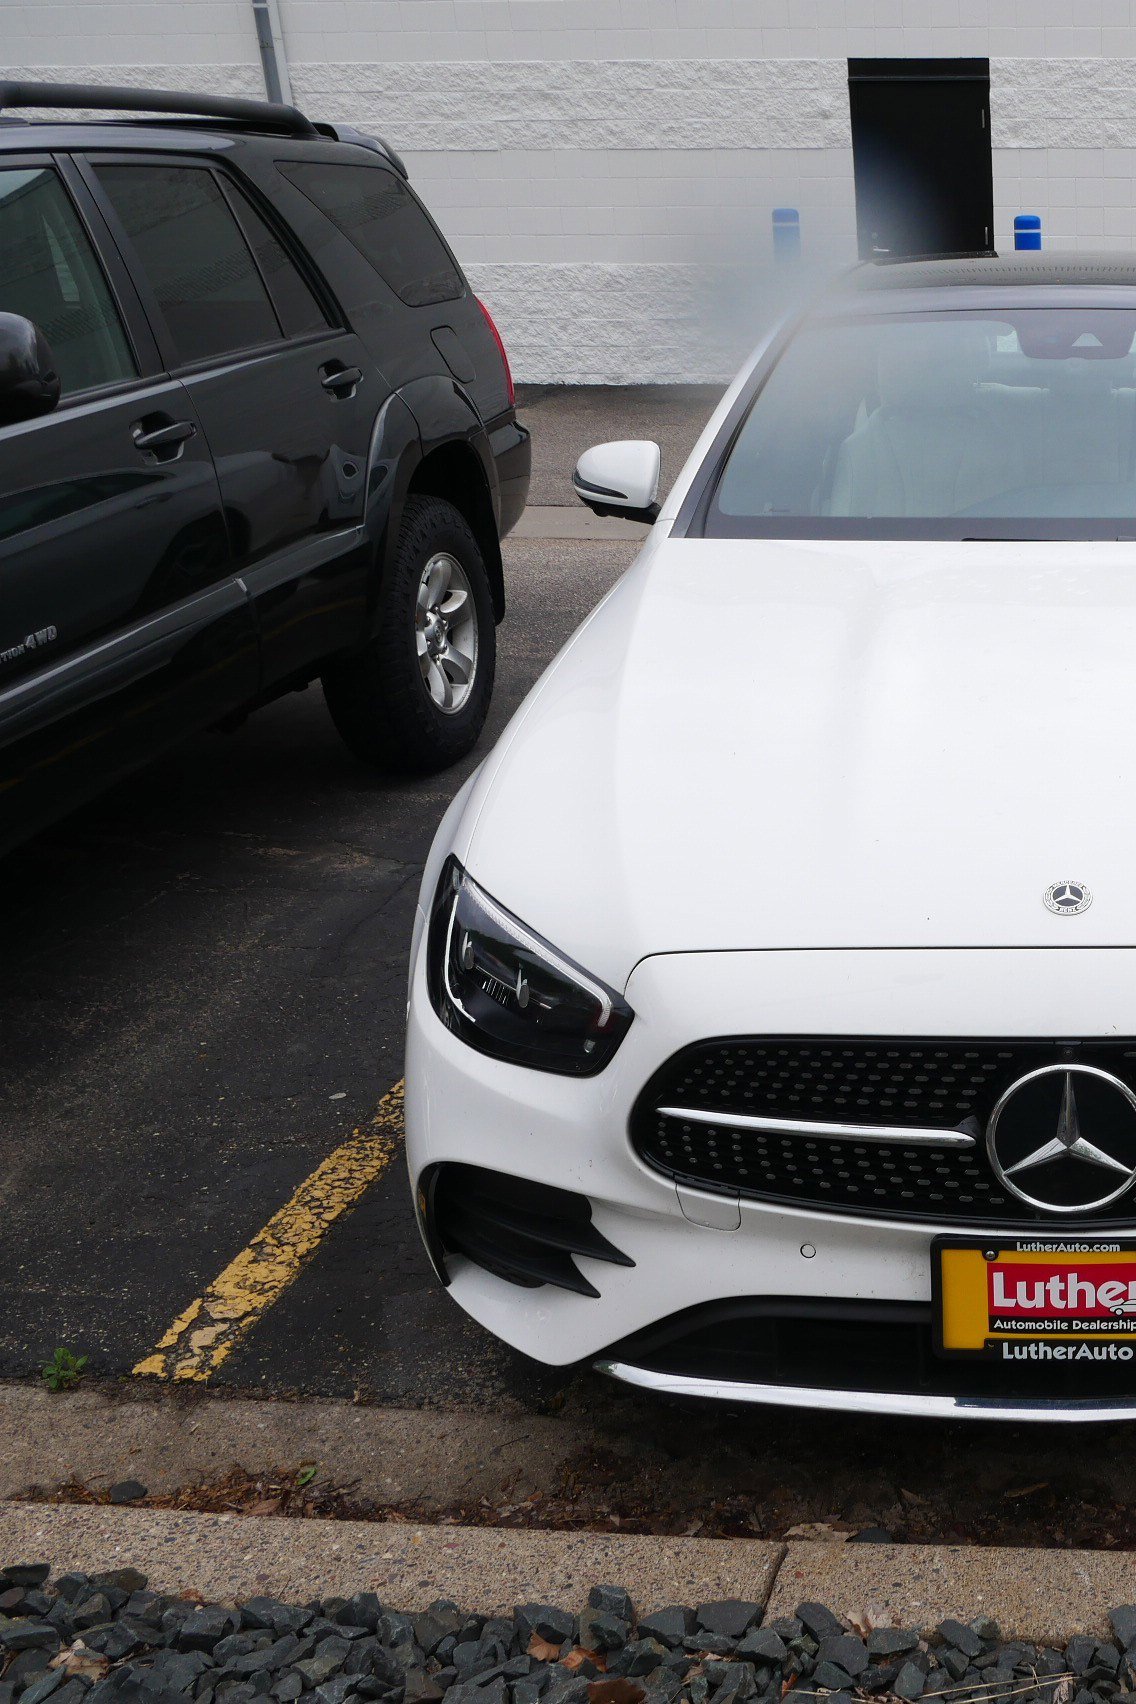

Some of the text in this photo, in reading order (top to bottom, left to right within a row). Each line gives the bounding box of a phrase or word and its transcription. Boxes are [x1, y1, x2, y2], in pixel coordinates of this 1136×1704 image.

[25, 625, 58, 649] 4WD
[1016, 1241, 1121, 1253] LutherAuto.com
[993, 1318, 1069, 1331] Automobile
[1002, 1341, 1134, 1361] LutherAuto
